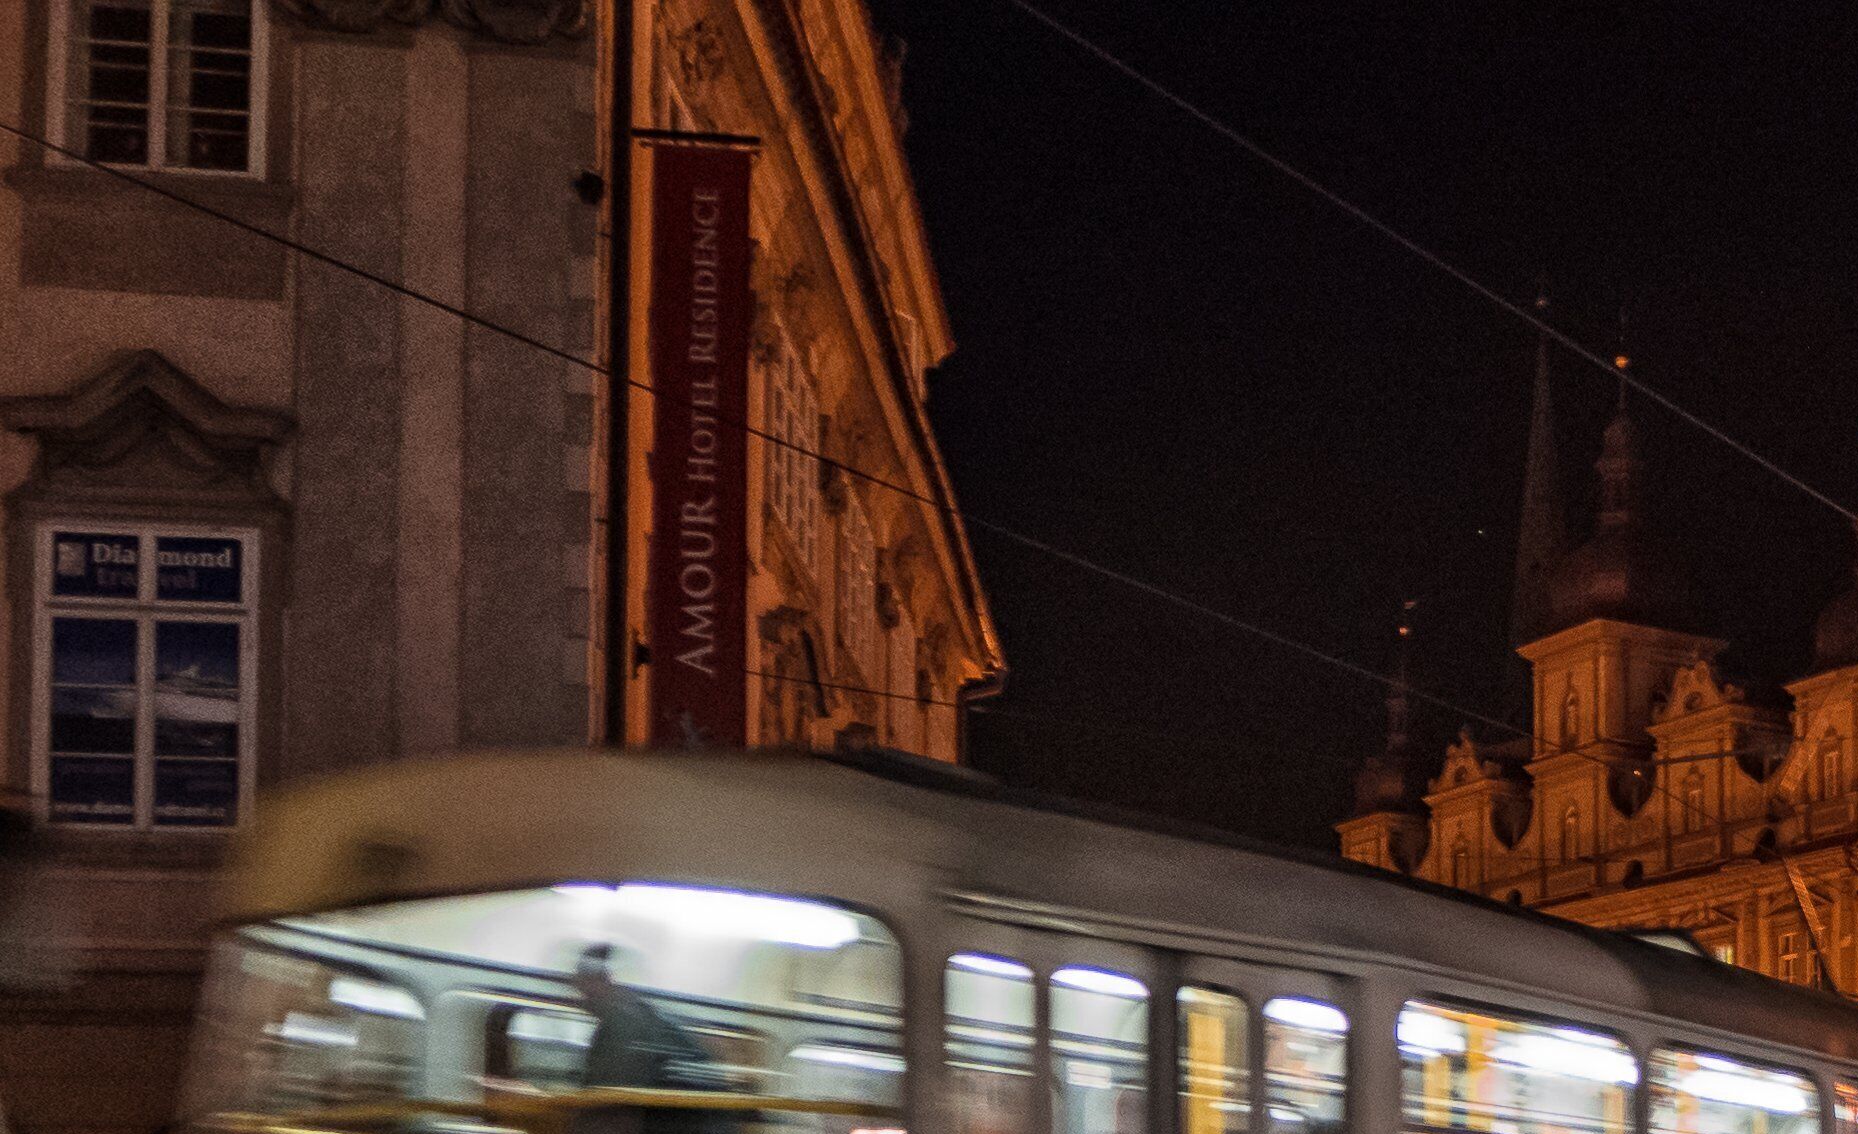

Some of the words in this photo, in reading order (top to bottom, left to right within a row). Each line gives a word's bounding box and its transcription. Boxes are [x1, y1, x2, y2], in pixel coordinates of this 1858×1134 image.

[689, 187, 719, 363] RESIDENCE
[687, 377, 718, 481] HOTEL
[675, 497, 717, 675] AMOUR
